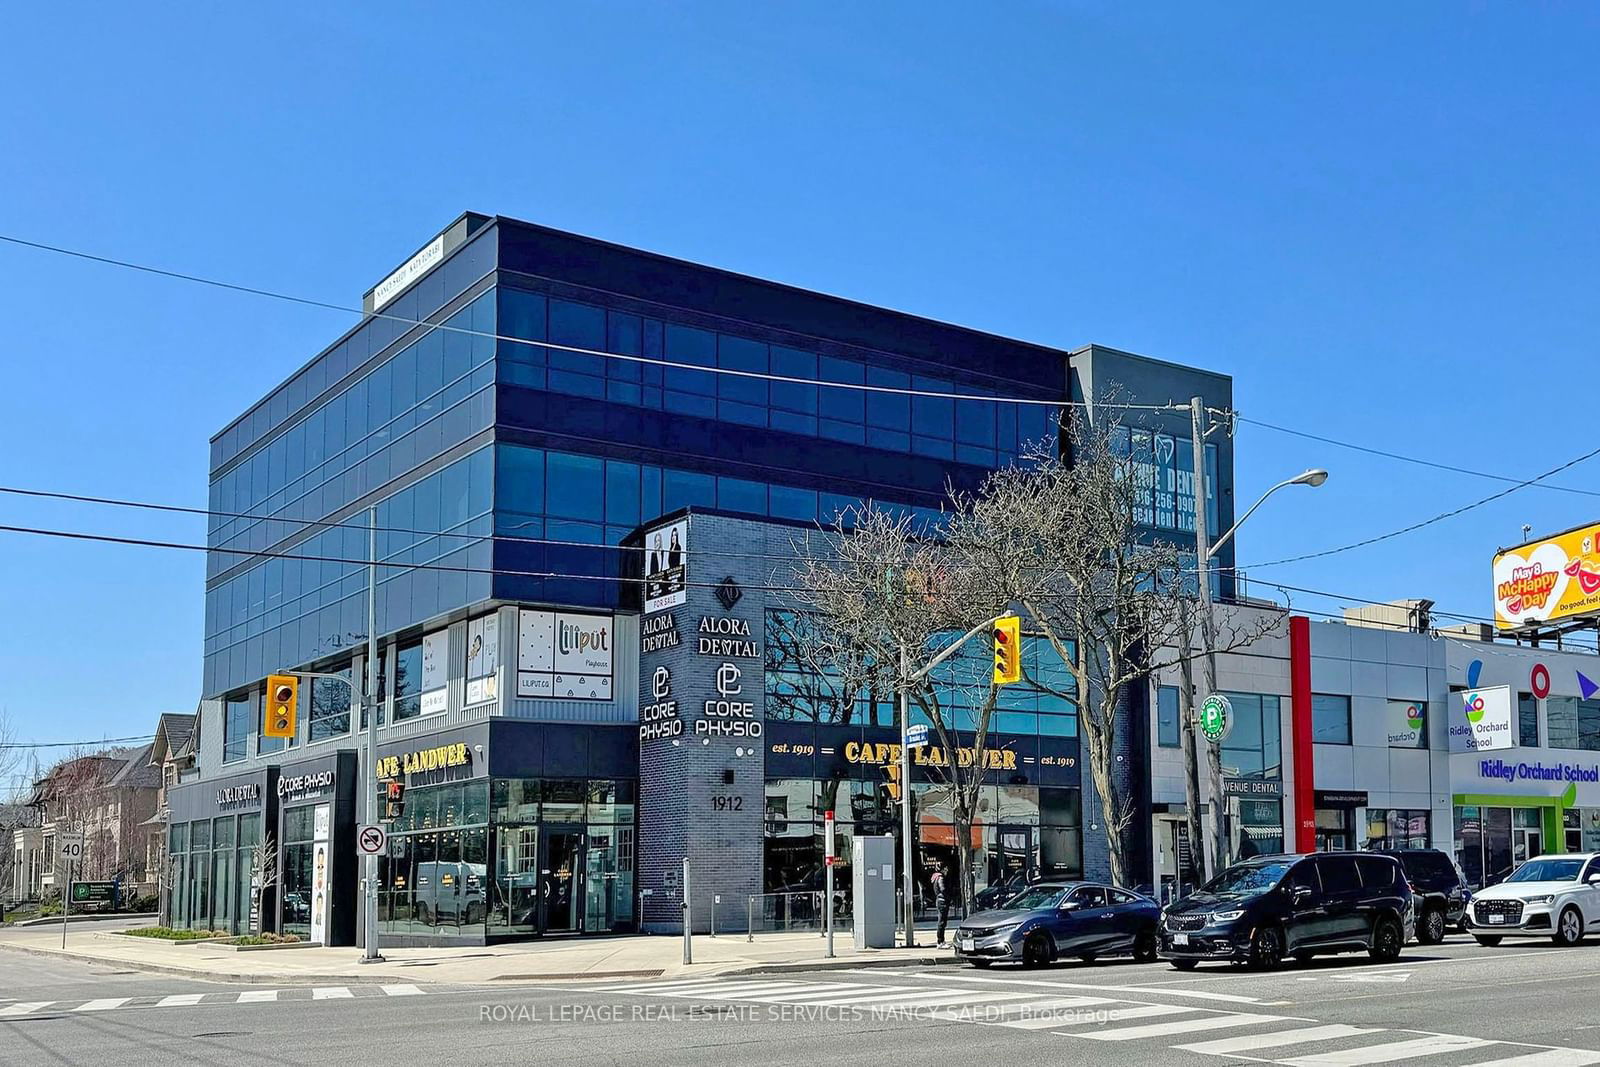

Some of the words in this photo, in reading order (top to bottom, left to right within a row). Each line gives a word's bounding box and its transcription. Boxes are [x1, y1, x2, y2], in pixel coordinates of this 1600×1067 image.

[1167, 468, 1213, 499] DENTL
[1513, 566, 1534, 581] May
[1533, 562, 1542, 576] 8
[1498, 571, 1559, 600] McHappy
[1521, 591, 1551, 611] Day
[643, 613, 673, 635] ALORA
[699, 616, 751, 636] ALORA
[644, 702, 675, 721] CORE
[705, 701, 754, 718] CORE
[640, 719, 682, 740] PHYSIO
[695, 720, 762, 737] PHYSIO
[1450, 726, 1473, 736] Ridley
[1477, 721, 1509, 733] Orchard
[1466, 737, 1493, 749] School
[376, 756, 400, 779] AFE
[403, 743, 467, 773] LANDWER
[772, 743, 790, 753] est.
[793, 745, 815, 756] 1919
[845, 741, 902, 765] CAFE
[1040, 756, 1056, 765] est.
[1058, 757, 1075, 767] 1919
[285, 776, 304, 793] CORE
[304, 770, 332, 789] PHYSIO
[1481, 760, 1517, 783] Ridley
[1518, 763, 1562, 781] Orchard
[1564, 766, 1599, 783] School
[1252, 783, 1279, 793] DENTAL
[711, 796, 743, 811] 1912
[62, 843, 80, 857] 40
